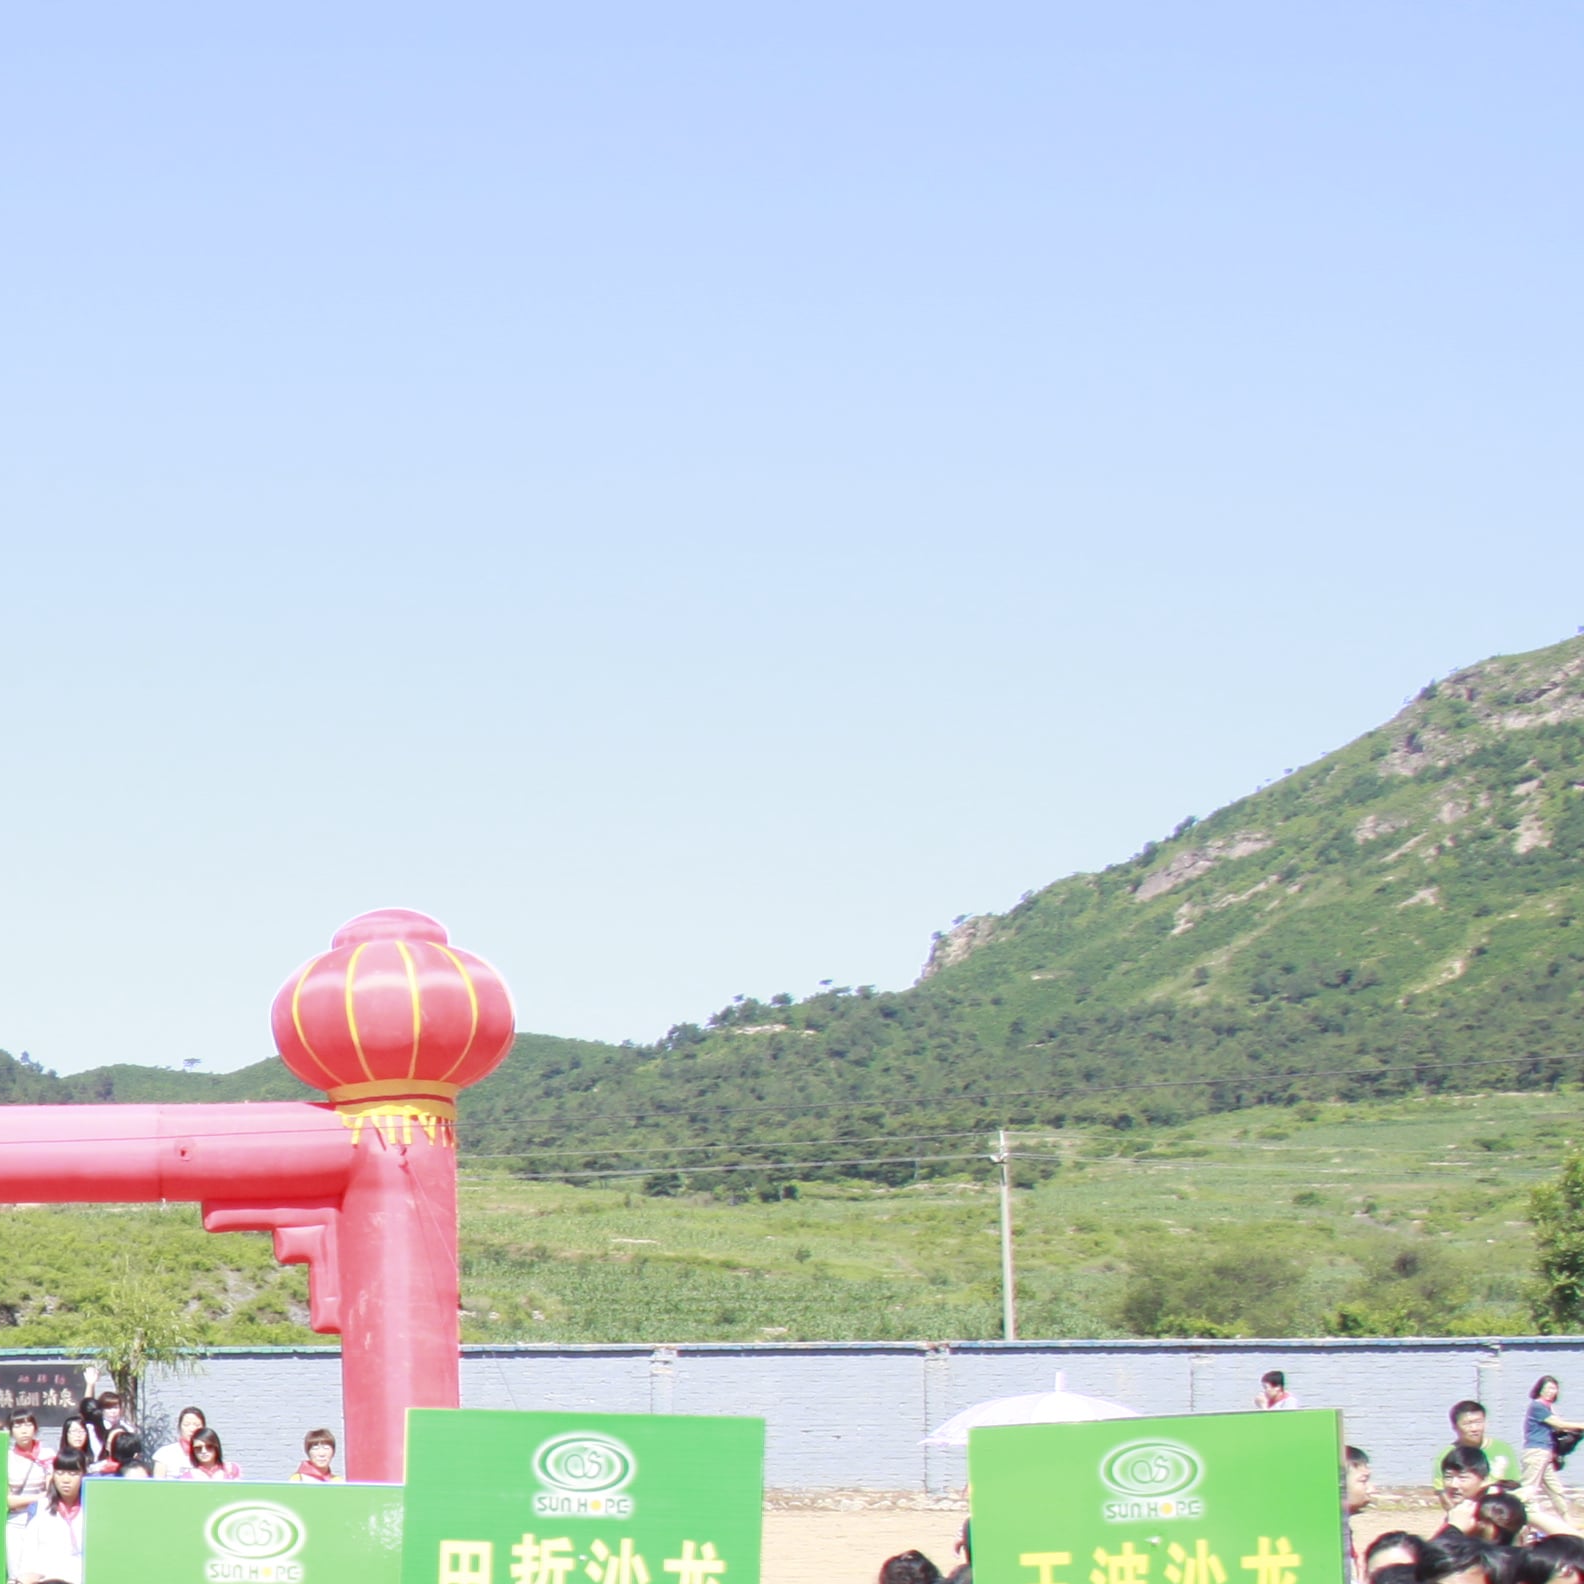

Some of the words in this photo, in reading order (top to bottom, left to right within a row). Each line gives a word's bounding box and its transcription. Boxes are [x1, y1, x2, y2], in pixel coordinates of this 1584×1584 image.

[536, 1496, 572, 1513] SUN
[578, 1496, 630, 1514] HOPE
[1106, 1502, 1143, 1519] SUN
[1148, 1500, 1202, 1517] HOPE
